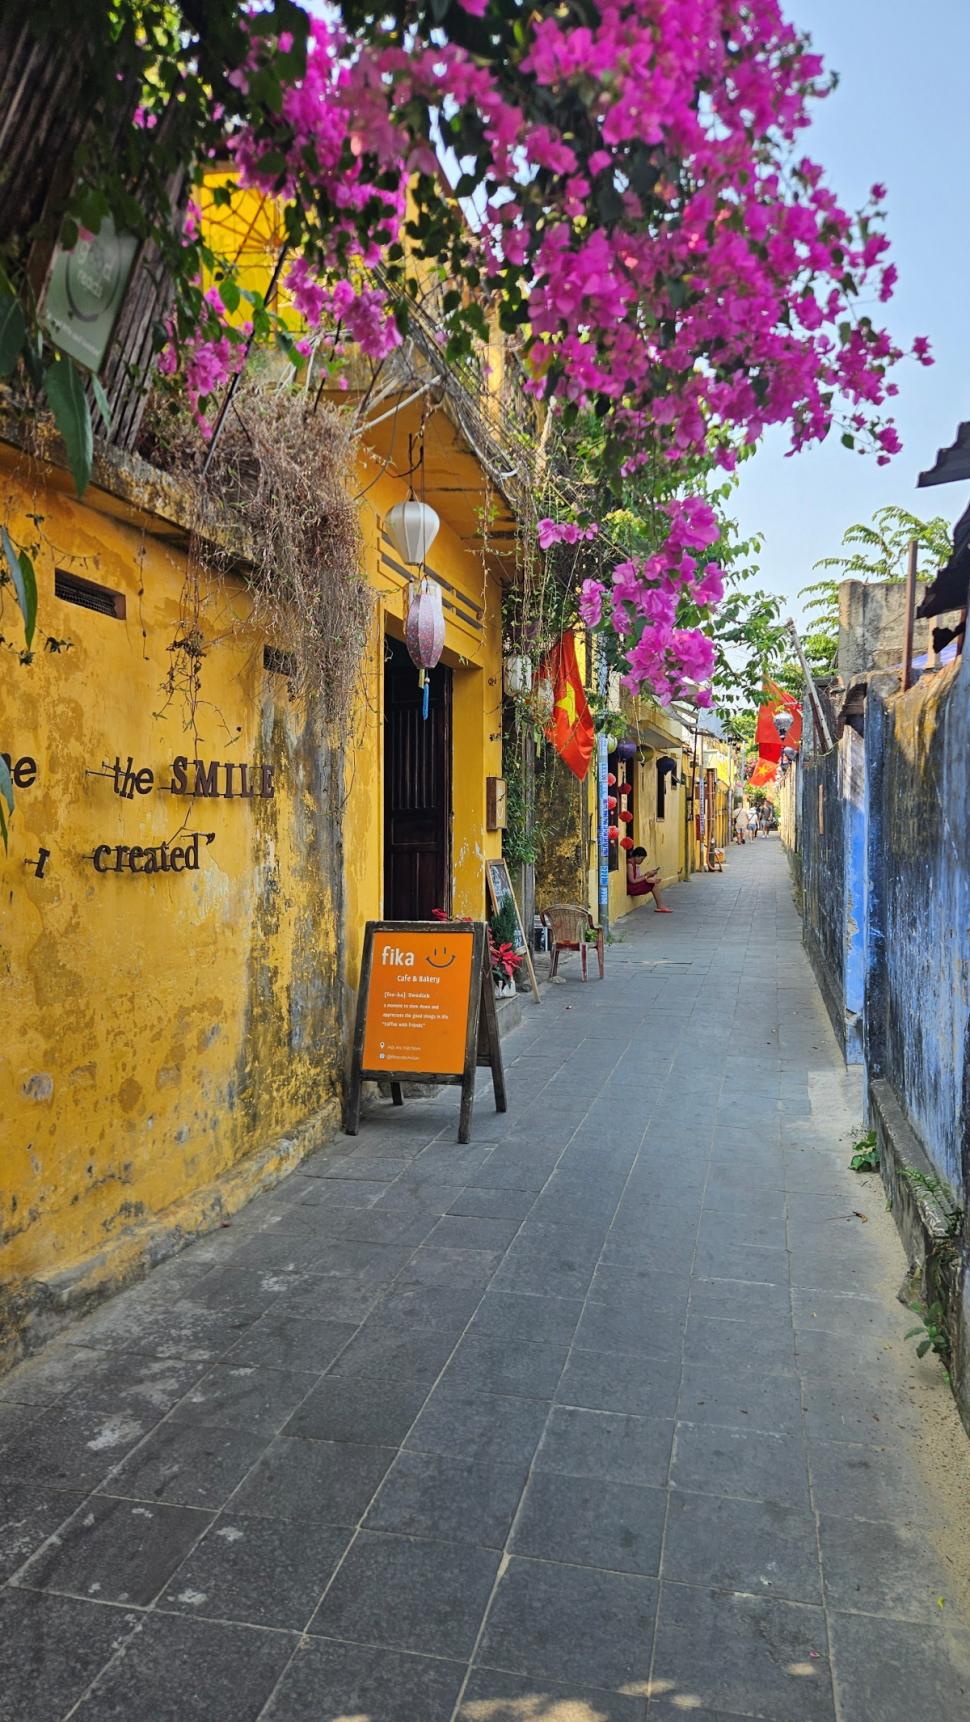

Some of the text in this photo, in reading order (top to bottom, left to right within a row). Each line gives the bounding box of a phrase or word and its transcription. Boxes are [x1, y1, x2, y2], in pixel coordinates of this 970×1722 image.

[113, 756, 154, 800] the
[171, 756, 275, 798] SMILE
[382, 945, 415, 966] fika
[419, 976, 440, 984] Bakery
